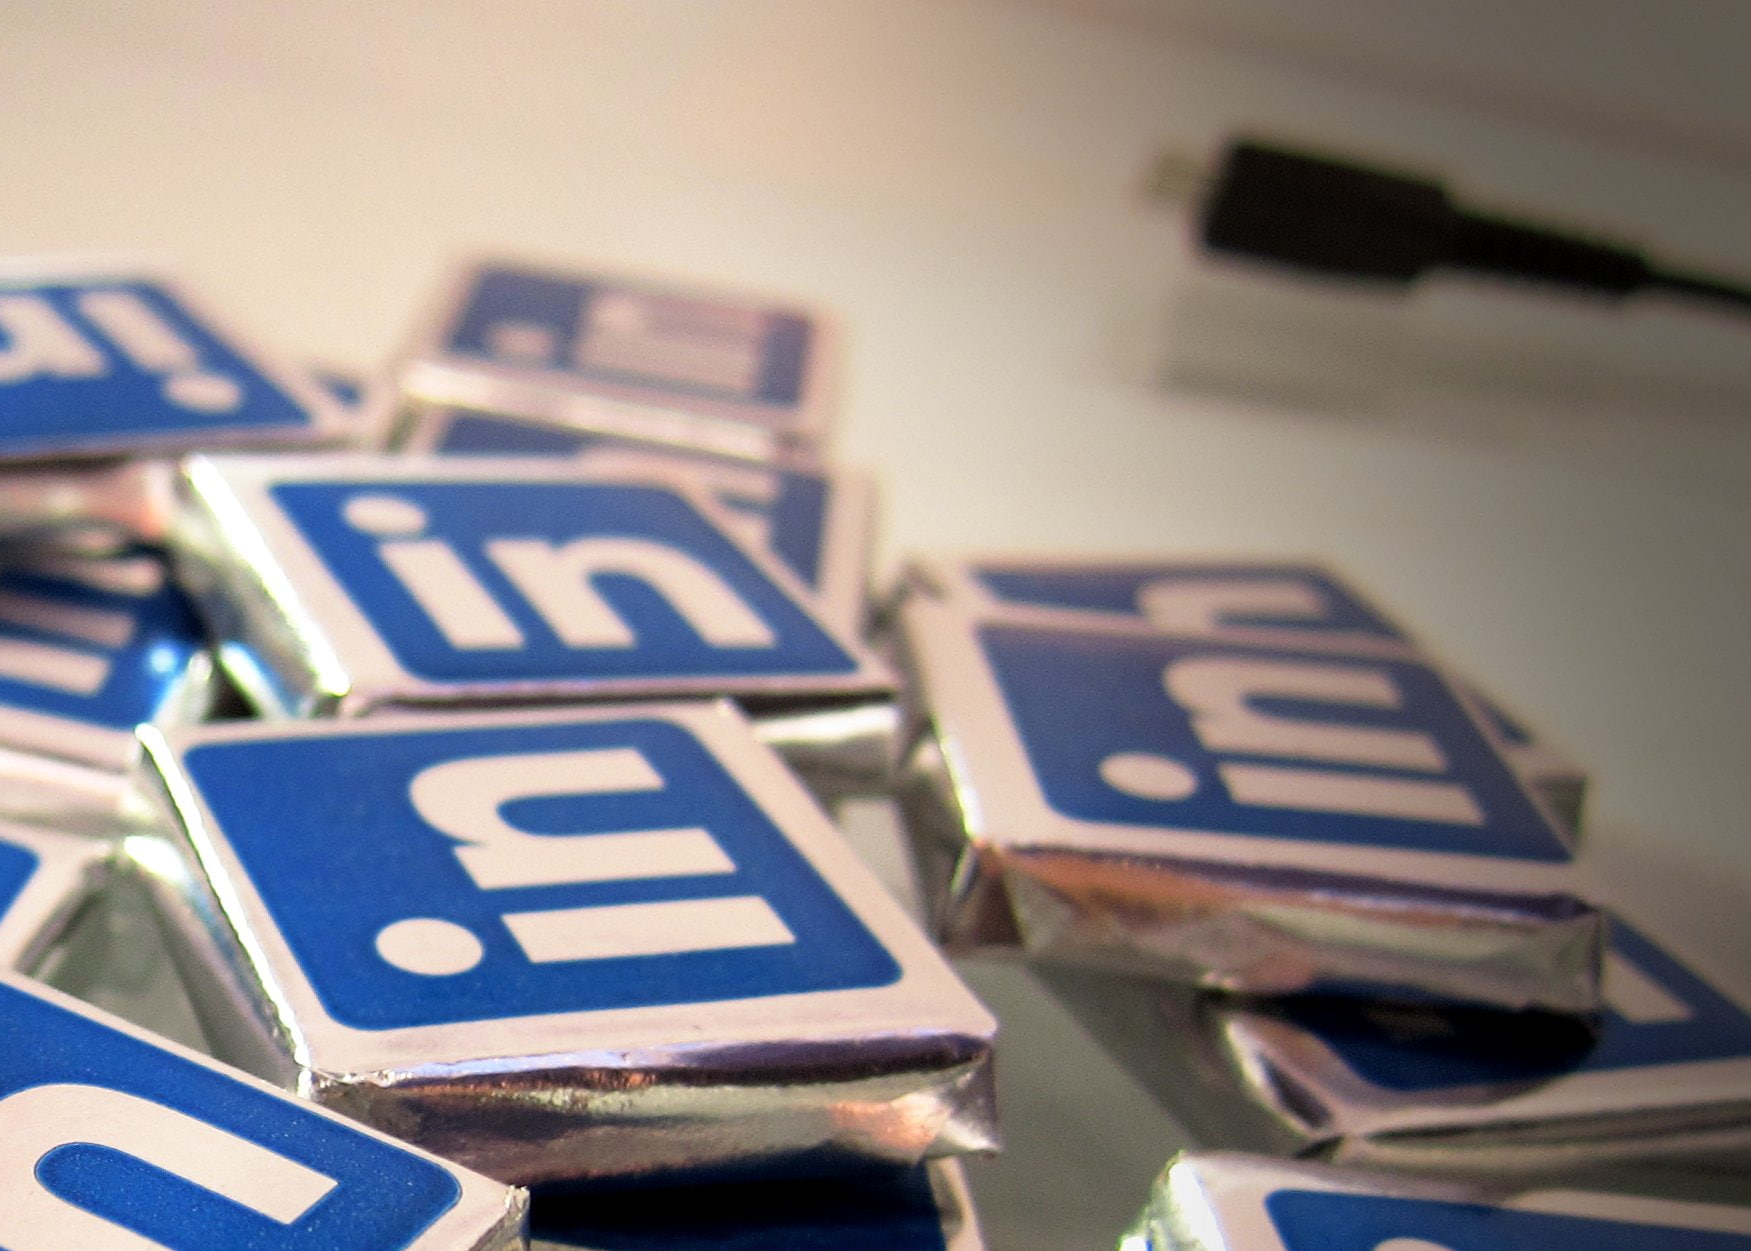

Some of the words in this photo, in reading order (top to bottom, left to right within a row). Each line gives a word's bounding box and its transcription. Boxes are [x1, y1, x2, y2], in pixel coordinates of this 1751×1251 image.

[341, 494, 778, 649] in
[1099, 654, 1486, 827] in
[374, 746, 798, 978] in
